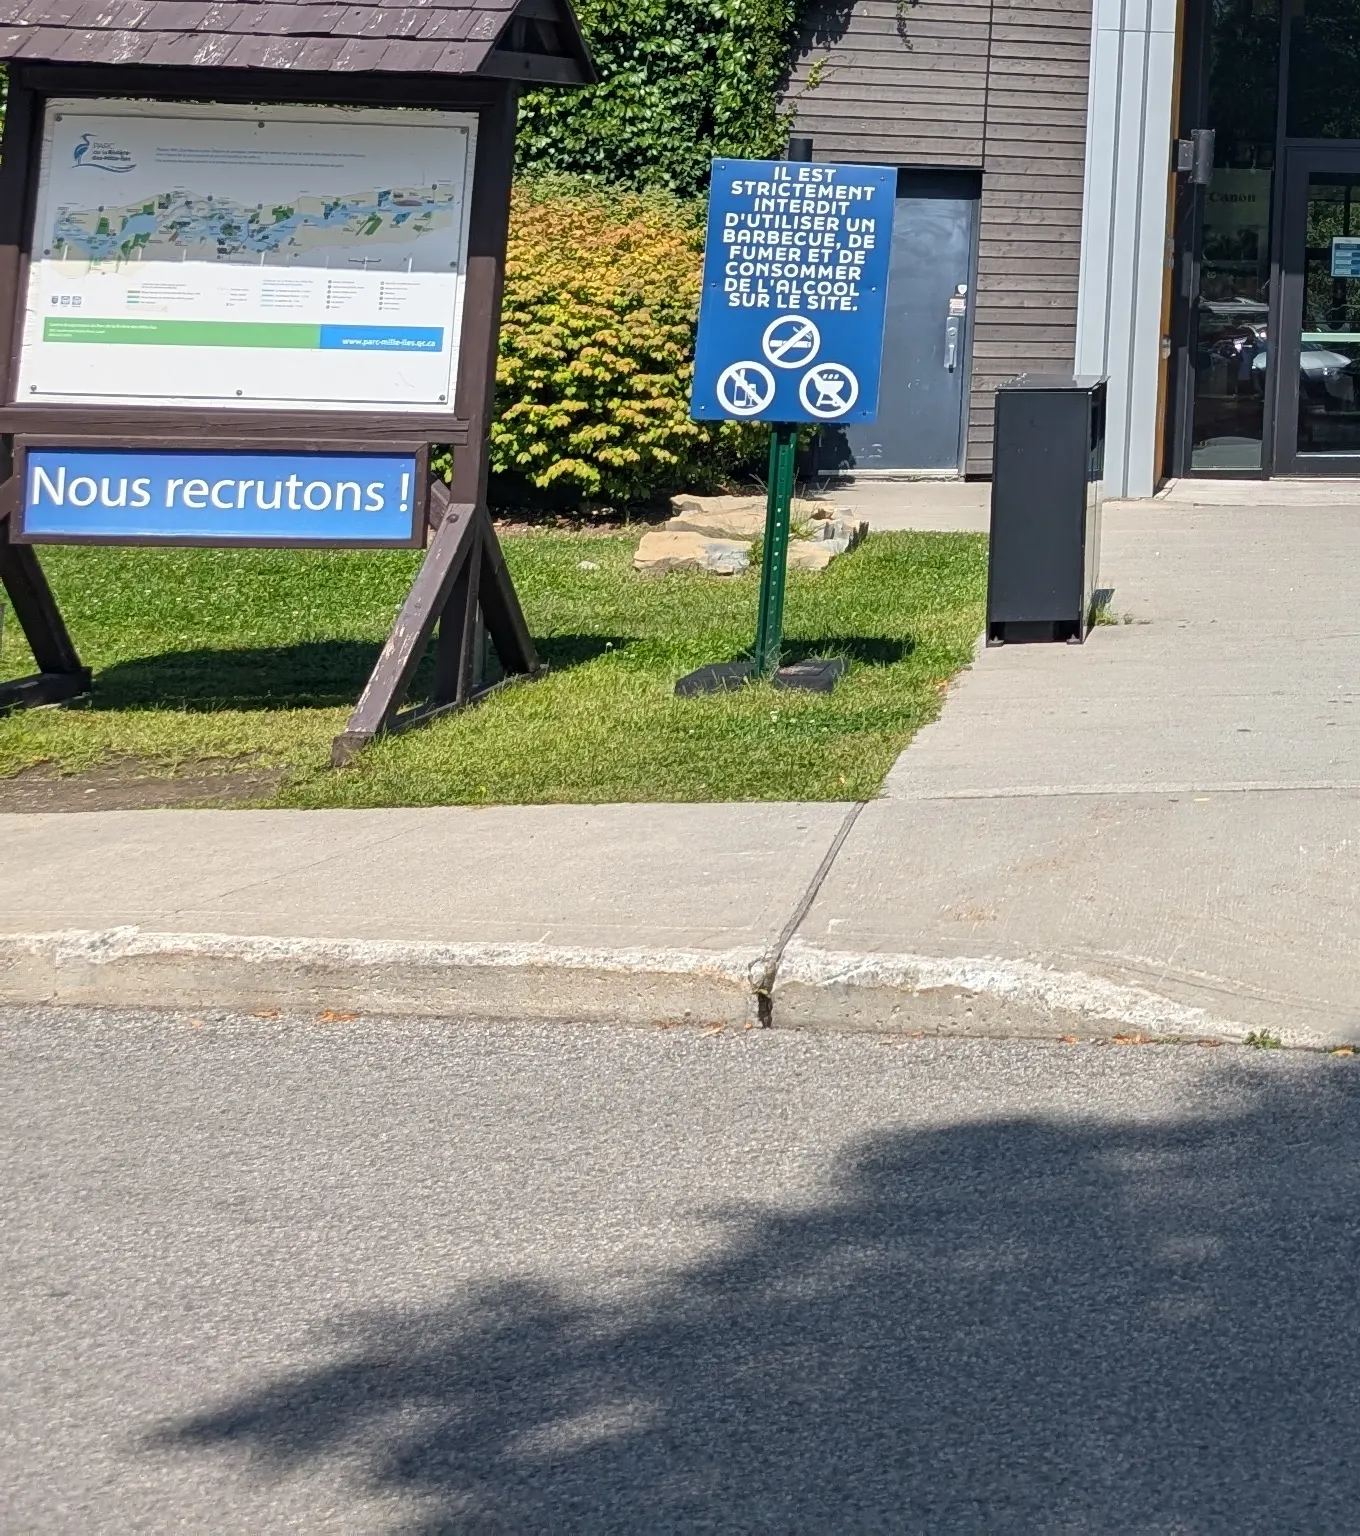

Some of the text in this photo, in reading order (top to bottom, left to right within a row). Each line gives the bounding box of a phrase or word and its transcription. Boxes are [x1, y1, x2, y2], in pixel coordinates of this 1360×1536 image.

[773, 166, 837, 183] IL EST
[731, 180, 876, 201] STRICTEMENT
[1209, 191, 1255, 202] Canon
[753, 197, 850, 216] INTERDIT
[724, 213, 876, 233] D'UTILISER UN
[723, 229, 875, 251] BARBECUE, DE
[729, 246, 866, 264] FUMER ET DE
[725, 261, 861, 281] CONSOMMER
[724, 278, 860, 297] DE L'ALCOOL
[728, 293, 858, 311] SUR LE SITE.
[32, 465, 409, 512] Nous recrutons !
